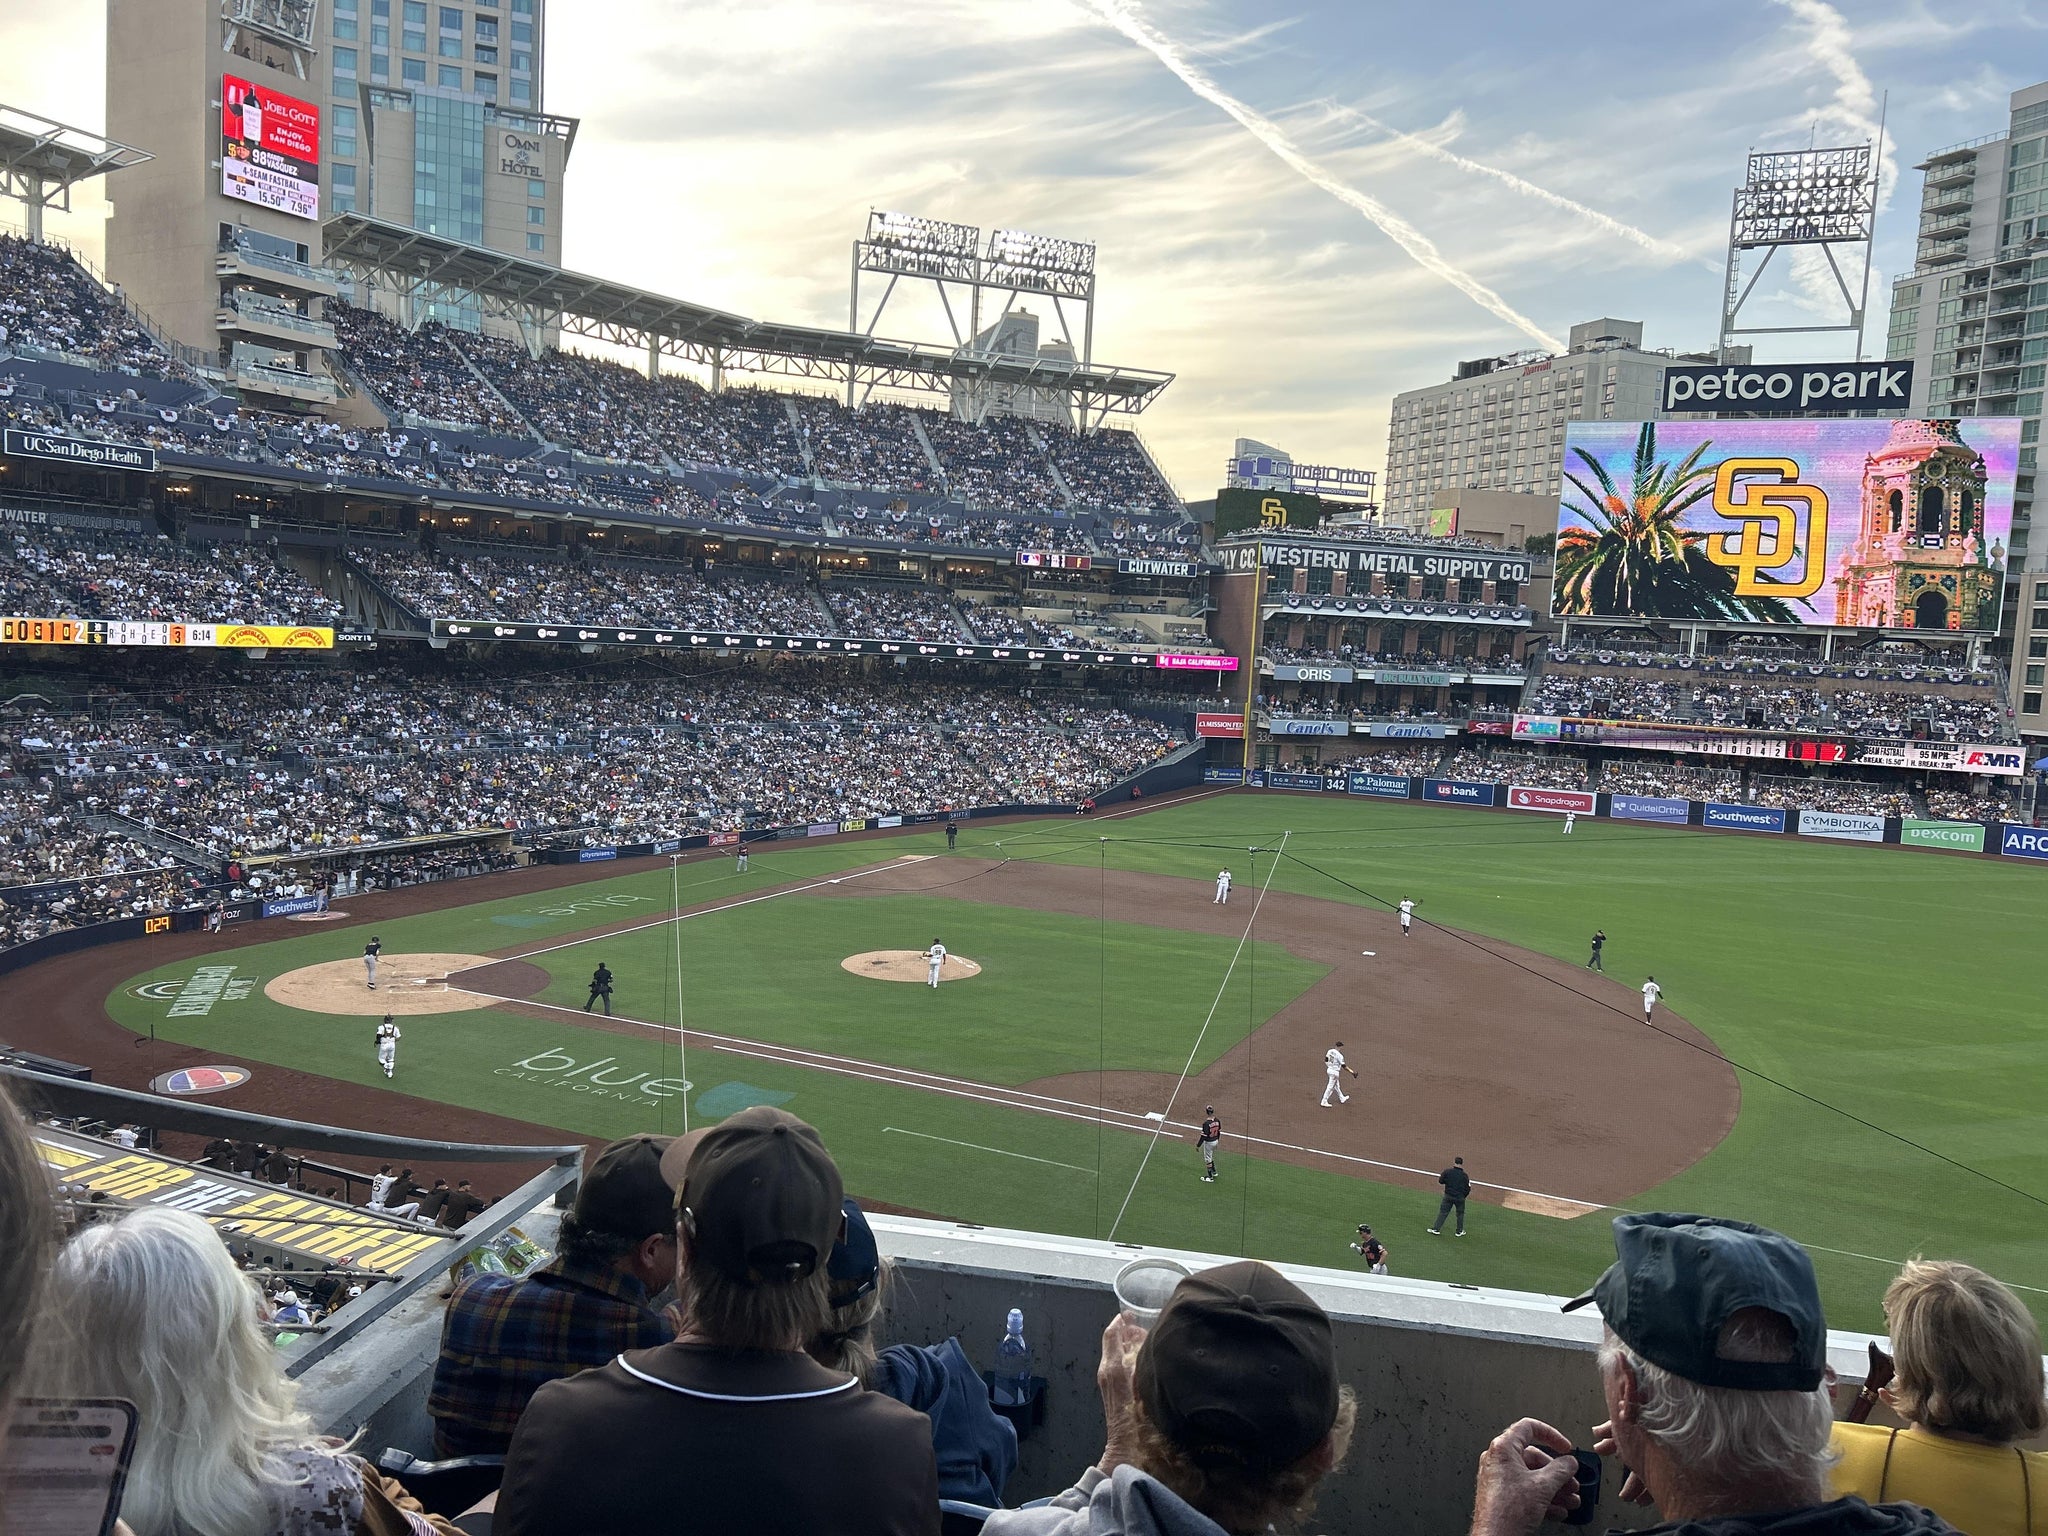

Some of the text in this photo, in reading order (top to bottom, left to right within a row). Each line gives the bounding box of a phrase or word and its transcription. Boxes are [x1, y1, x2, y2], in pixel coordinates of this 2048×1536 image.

[264, 100, 289, 117] JOEL
[289, 108, 316, 126] GOTT
[269, 133, 311, 153] SAN DIEGO
[277, 127, 305, 143] ENJOY,
[505, 134, 540, 152] OMNI
[252, 148, 267, 165] 98
[268, 158, 298, 176] VASQUEZ
[501, 159, 542, 177] HOTEL
[242, 166, 268, 181] 4-SEAM
[269, 174, 300, 191] FASTBALL
[235, 184, 247, 196] 95
[1667, 367, 1907, 409] petco park
[23, 436, 142, 465] UC San Diego Health
[1706, 457, 1829, 598] SD
[1129, 559, 1189, 575] CUTWATER
[1261, 545, 1528, 582] WESTERN METAL SUPPLY CO.
[74, 622, 85, 643] 2
[175, 631, 181, 644] 3
[192, 629, 211, 641] 6:14
[1297, 668, 1332, 681] ORIS
[1778, 676, 1817, 684] LANDING
[1286, 721, 1335, 735] Canel's
[1385, 723, 1432, 737] Canel's
[1256, 731, 1274, 742] 336
[1833, 745, 1843, 761] 2
[1880, 747, 1906, 757] FASTBALL
[1919, 750, 1930, 759] 95
[1967, 752, 2021, 768] AMR
[1326, 779, 1345, 790] 342
[1366, 776, 1406, 789] Palomar
[1452, 785, 1479, 797] bank
[1534, 795, 1585, 808] Snapdragon
[1629, 803, 1685, 815] QuidelOrtho
[1709, 809, 1771, 825] Southwest
[1802, 816, 1880, 830] CYMBIOTIKA
[269, 900, 318, 915] Southwest
[511, 1047, 694, 1097] blue
[493, 1068, 659, 1107] CALIFORNIA
[60, 1156, 196, 1200] FOR
[151, 1179, 256, 1214] THE
[372, 1181, 381, 1192] 25
